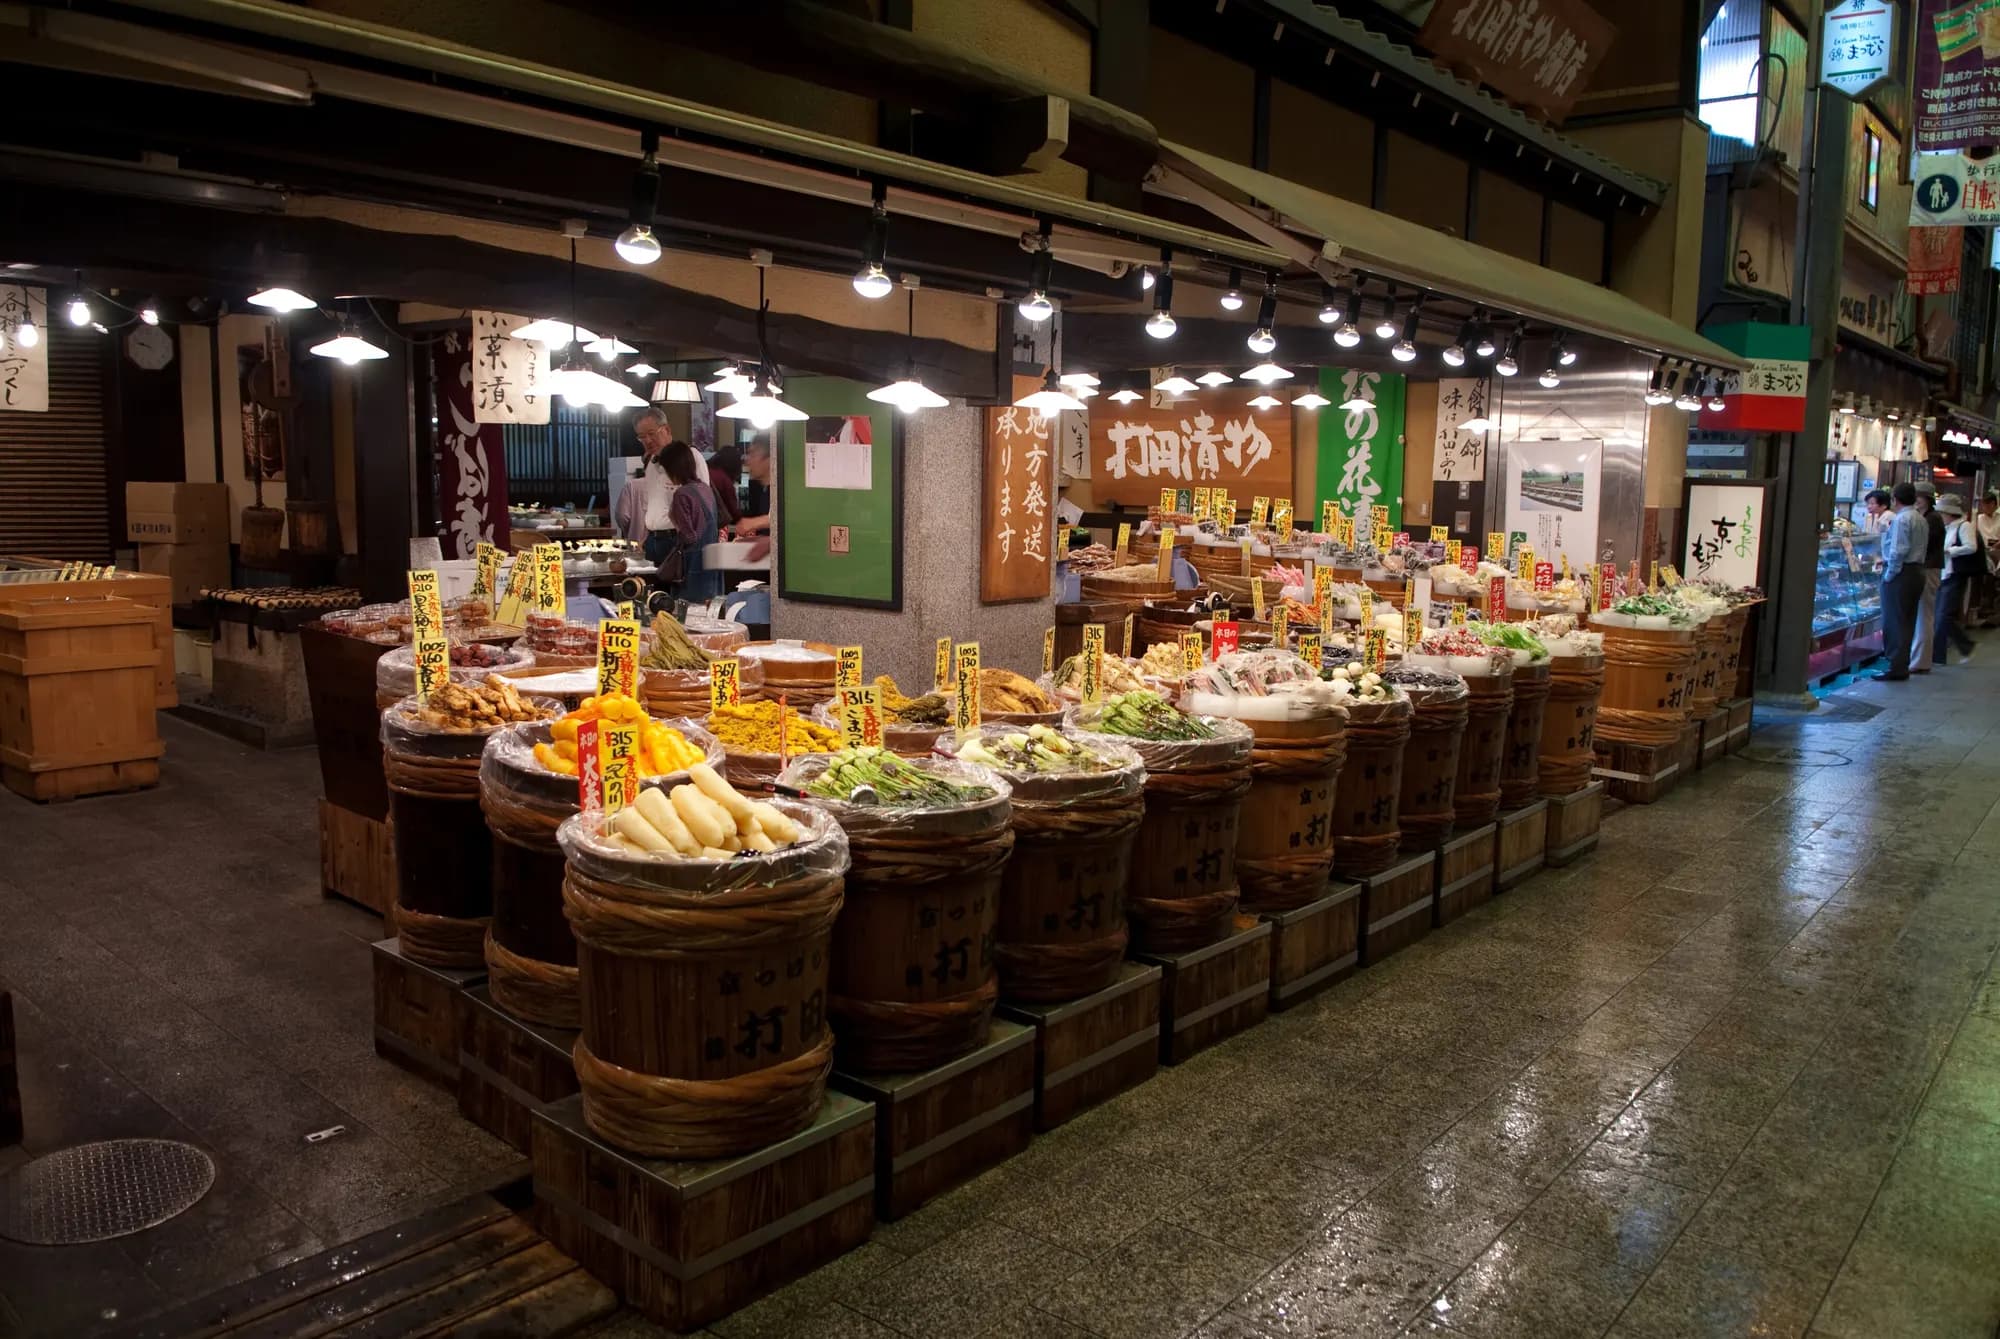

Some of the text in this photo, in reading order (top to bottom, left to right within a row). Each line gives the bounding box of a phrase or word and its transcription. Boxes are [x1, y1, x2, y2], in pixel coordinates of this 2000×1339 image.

[1847, 41, 1885, 60] まつむら
[1962, 180, 2000, 211] 自転
[1763, 372, 1803, 392] まつむら
[1072, 411, 1089, 475] います
[1105, 409, 1273, 481] 打田漬物
[996, 407, 1022, 565] 承ります
[1022, 405, 1049, 563] 地方発送
[412, 572, 437, 584] 100g
[604, 622, 635, 637] 100g
[1216, 628, 1237, 639] 本日の
[419, 642, 446, 654] 100g
[841, 690, 876, 707] ¥315
[1667, 687, 1683, 708] 打
[604, 730, 636, 748] ¥315
[1304, 813, 1328, 847] 打
[1192, 848, 1225, 884] 打
